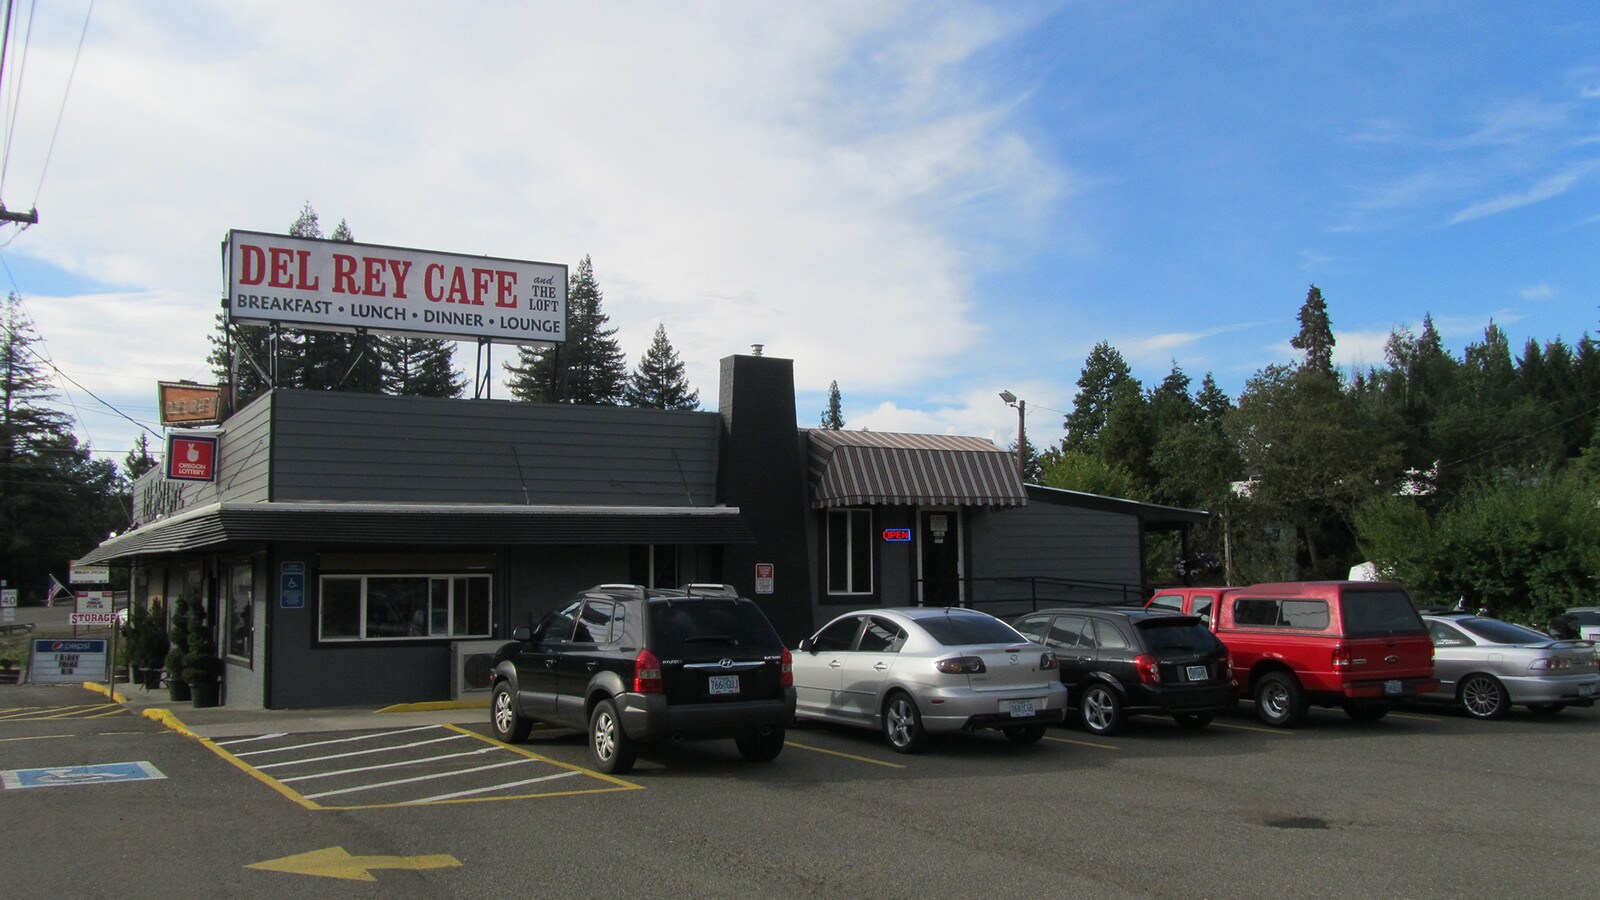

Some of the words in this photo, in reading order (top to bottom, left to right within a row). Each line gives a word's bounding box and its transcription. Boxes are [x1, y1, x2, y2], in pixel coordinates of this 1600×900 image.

[239, 244, 319, 291] DEL
[332, 253, 412, 299] REY
[424, 263, 518, 309] CAFE
[533, 275, 555, 285] and
[532, 285, 556, 298] THE
[529, 298, 559, 312] LOFT
[237, 294, 333, 315] BREAKFAST
[350, 303, 406, 321] LUNCH
[424, 309, 484, 327] DINNER
[500, 316, 560, 333] LOUNGE
[178, 462, 207, 470] OREGON
[883, 531, 909, 539] OPEN
[2, 596, 16, 605] 40
[71, 613, 116, 624] STORAGE
[64, 642, 90, 650] pepsi
